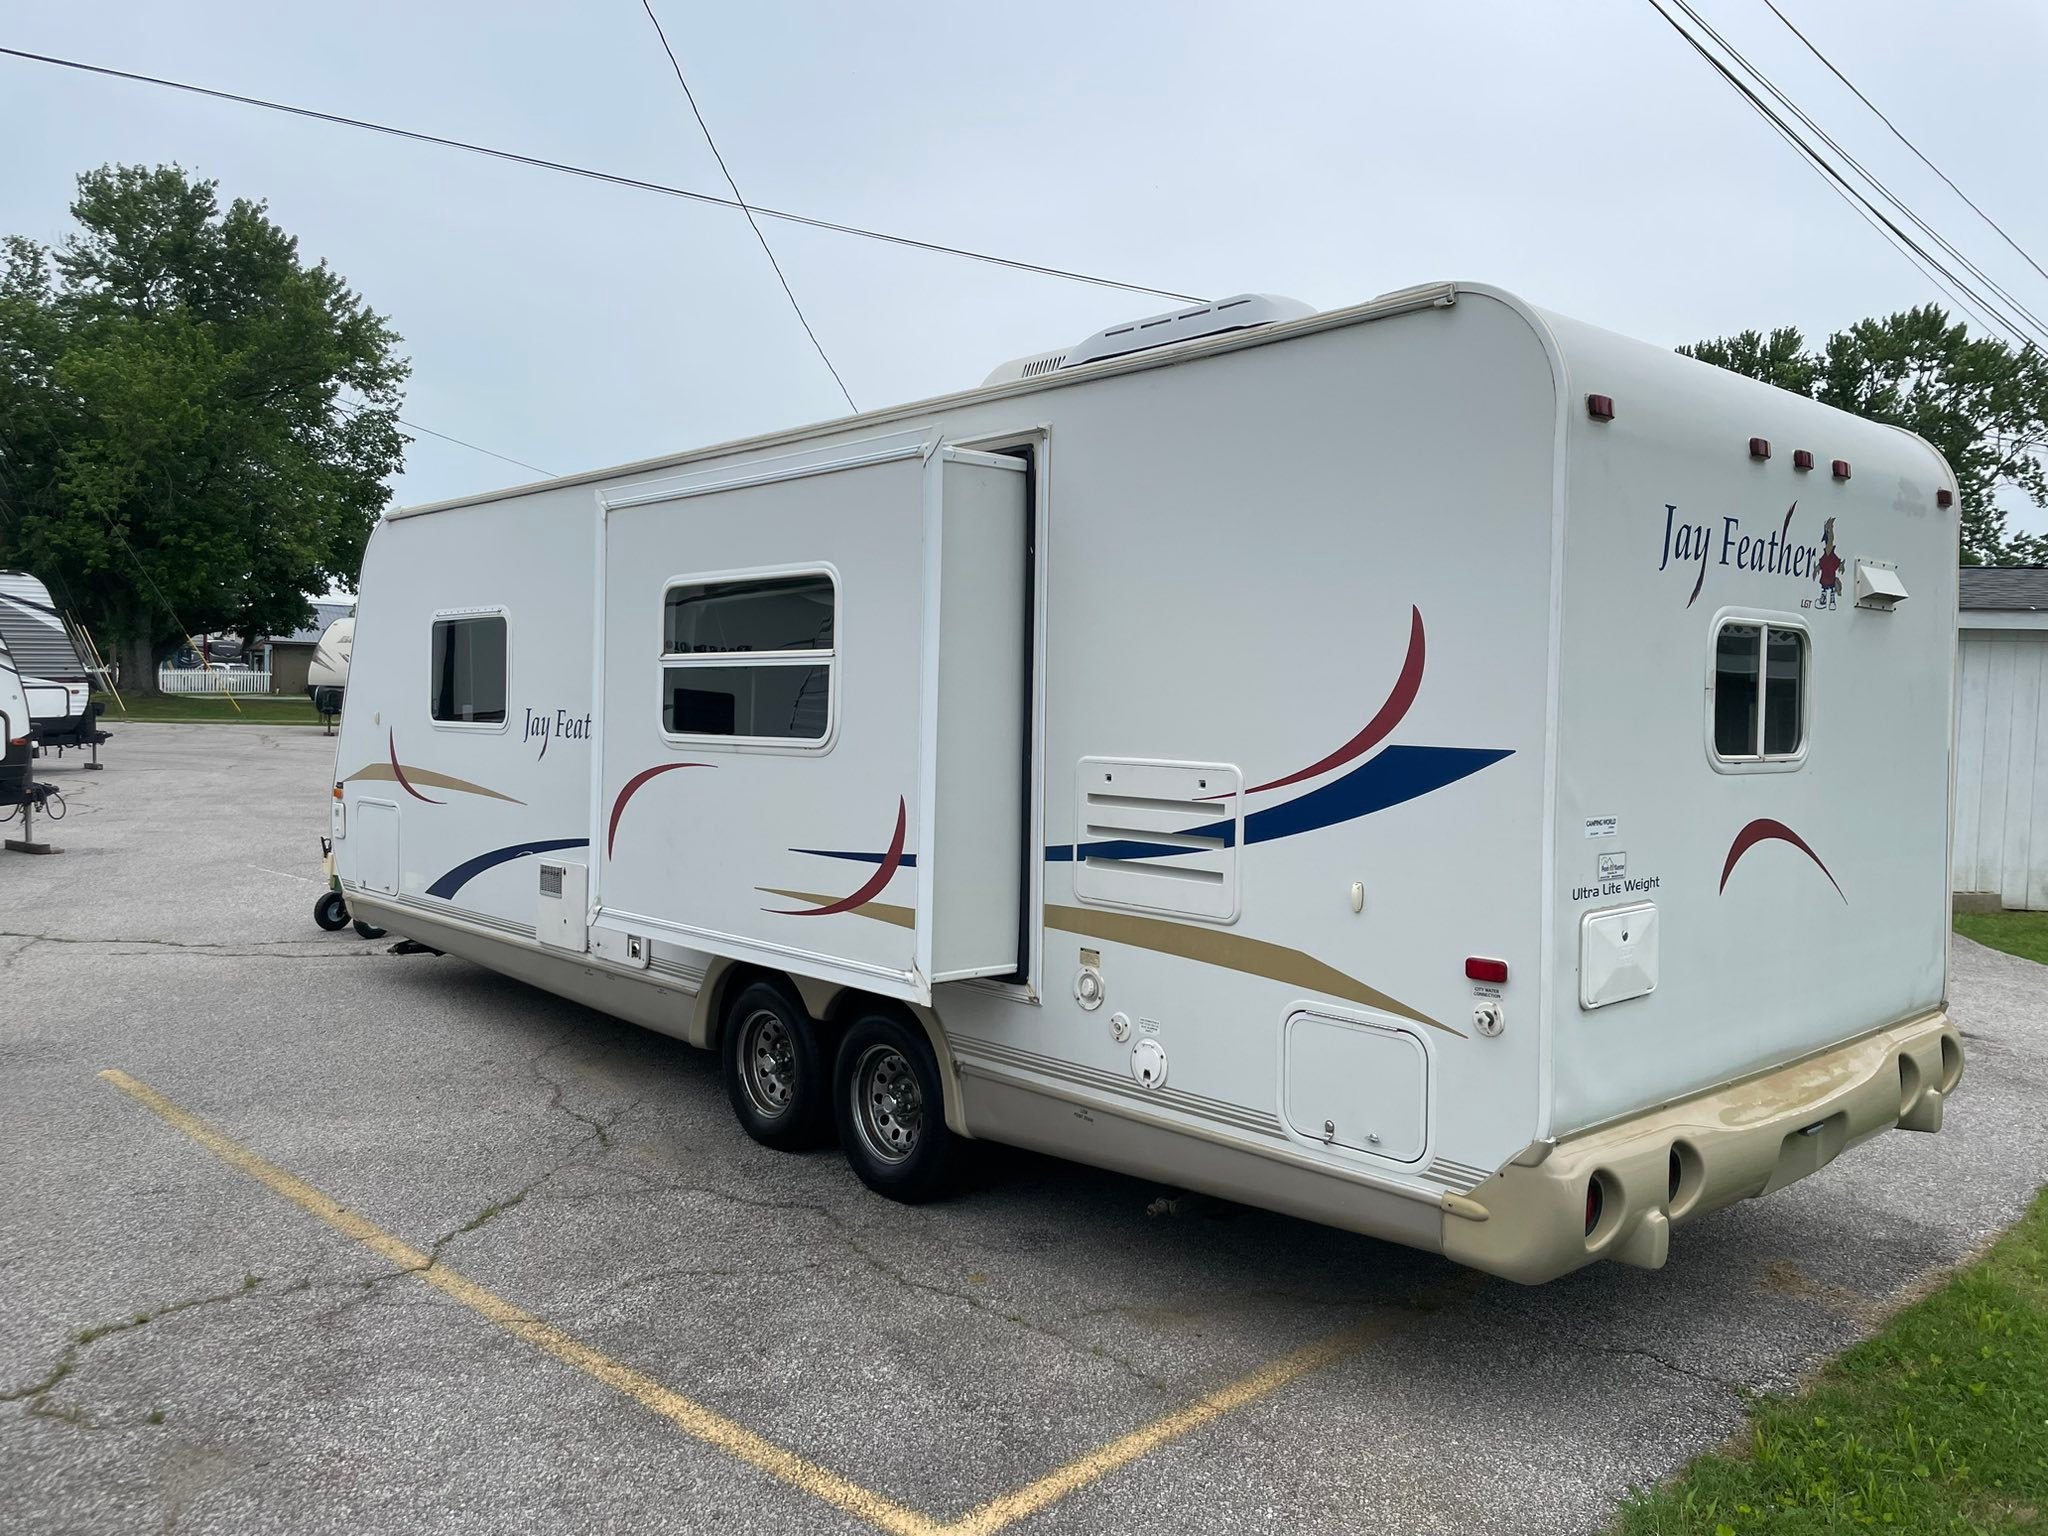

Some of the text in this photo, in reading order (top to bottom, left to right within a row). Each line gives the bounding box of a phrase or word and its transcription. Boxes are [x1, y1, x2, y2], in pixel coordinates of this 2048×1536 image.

[1658, 500, 1816, 609] Jay Feather
[1800, 599, 1812, 608] LGT
[523, 708, 551, 762] Jay
[1572, 876, 1660, 900] Ultra Lite Weight
